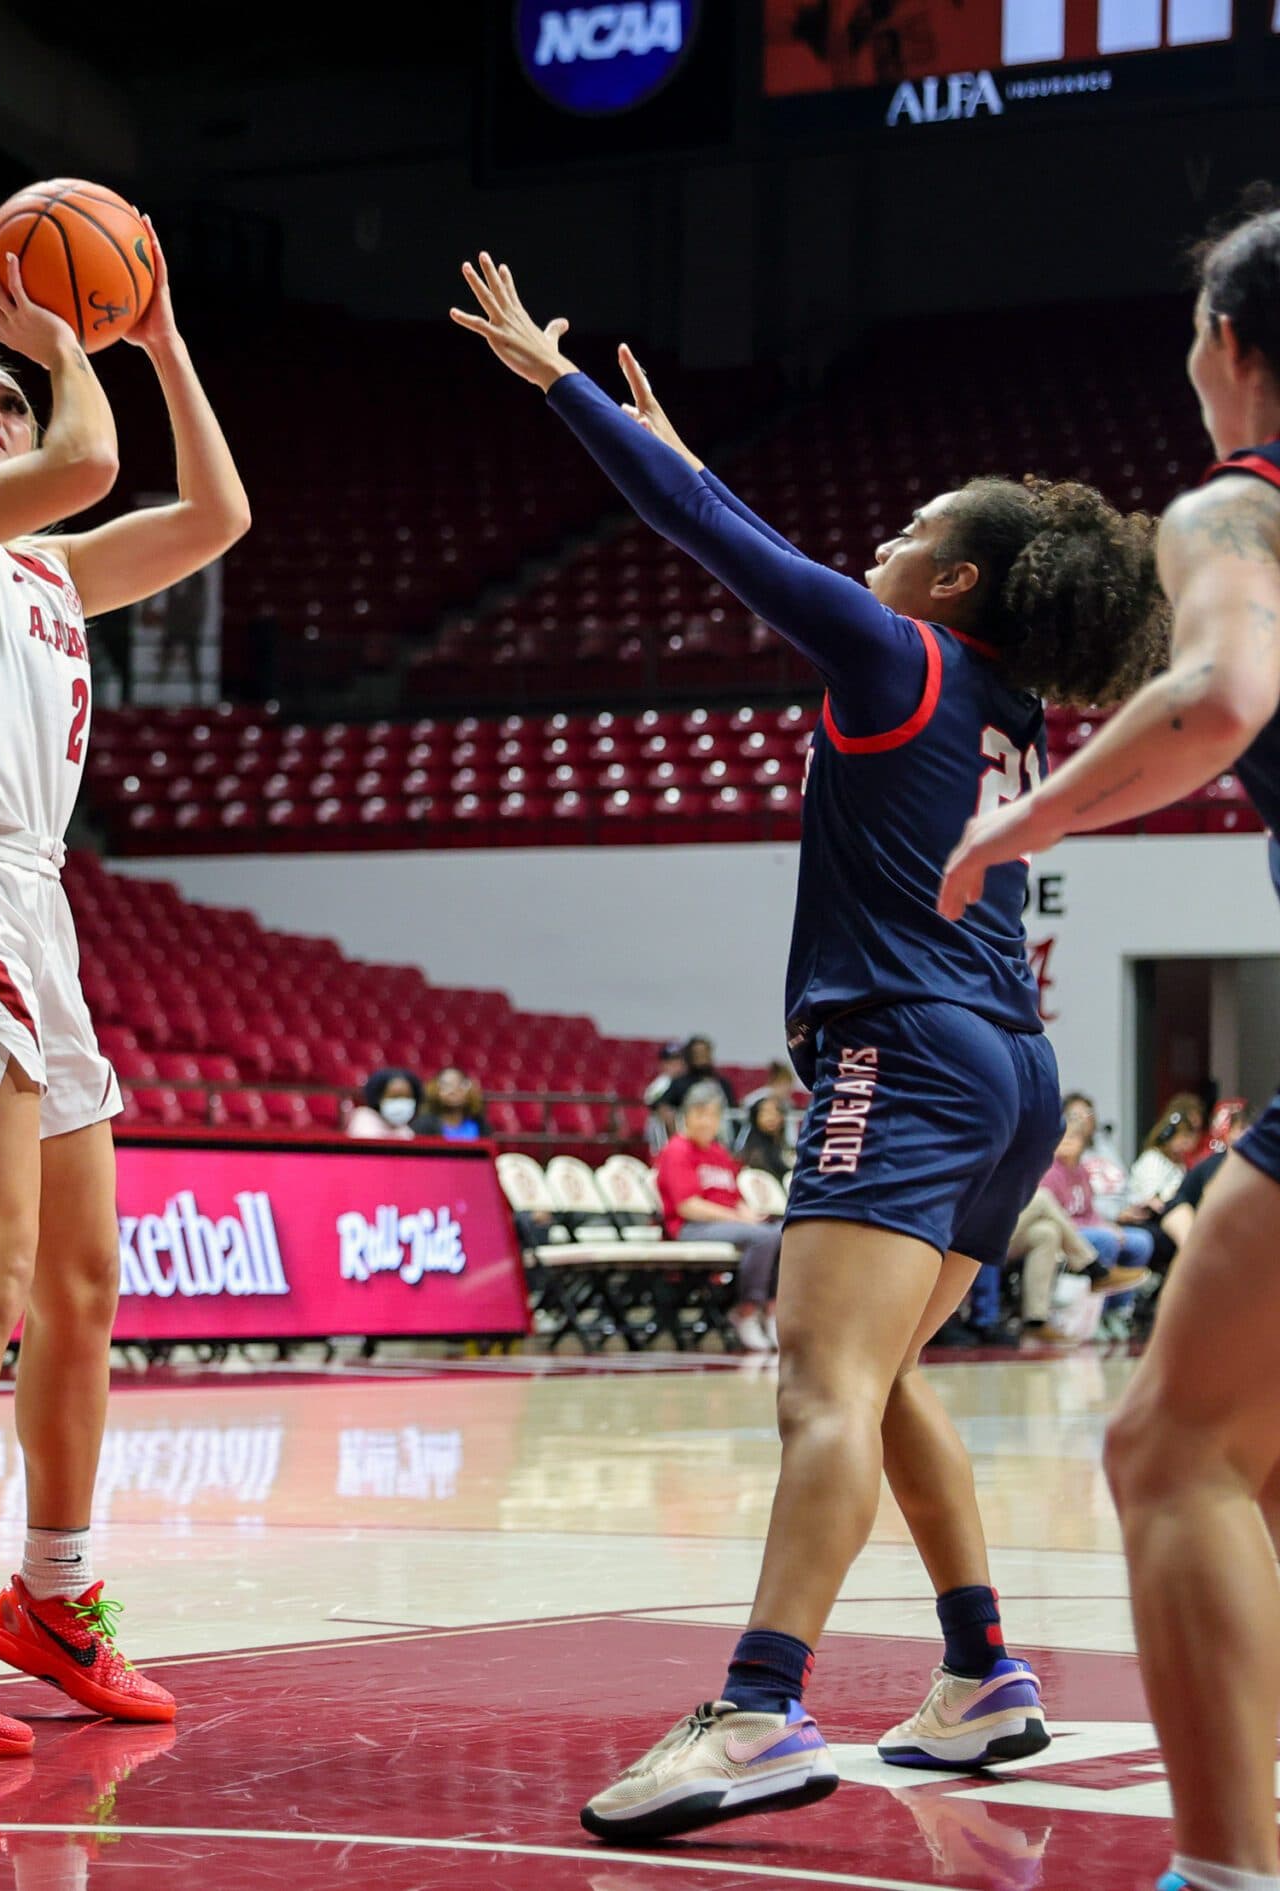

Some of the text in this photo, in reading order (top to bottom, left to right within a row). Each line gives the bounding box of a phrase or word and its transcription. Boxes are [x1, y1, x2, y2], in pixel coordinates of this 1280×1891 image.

[534, 1, 682, 65] NCAA
[886, 69, 1004, 127] ALFA
[66, 678, 89, 765] 2
[818, 1046, 878, 1173] COUGARS
[336, 1204, 467, 1285] Roll Tide
